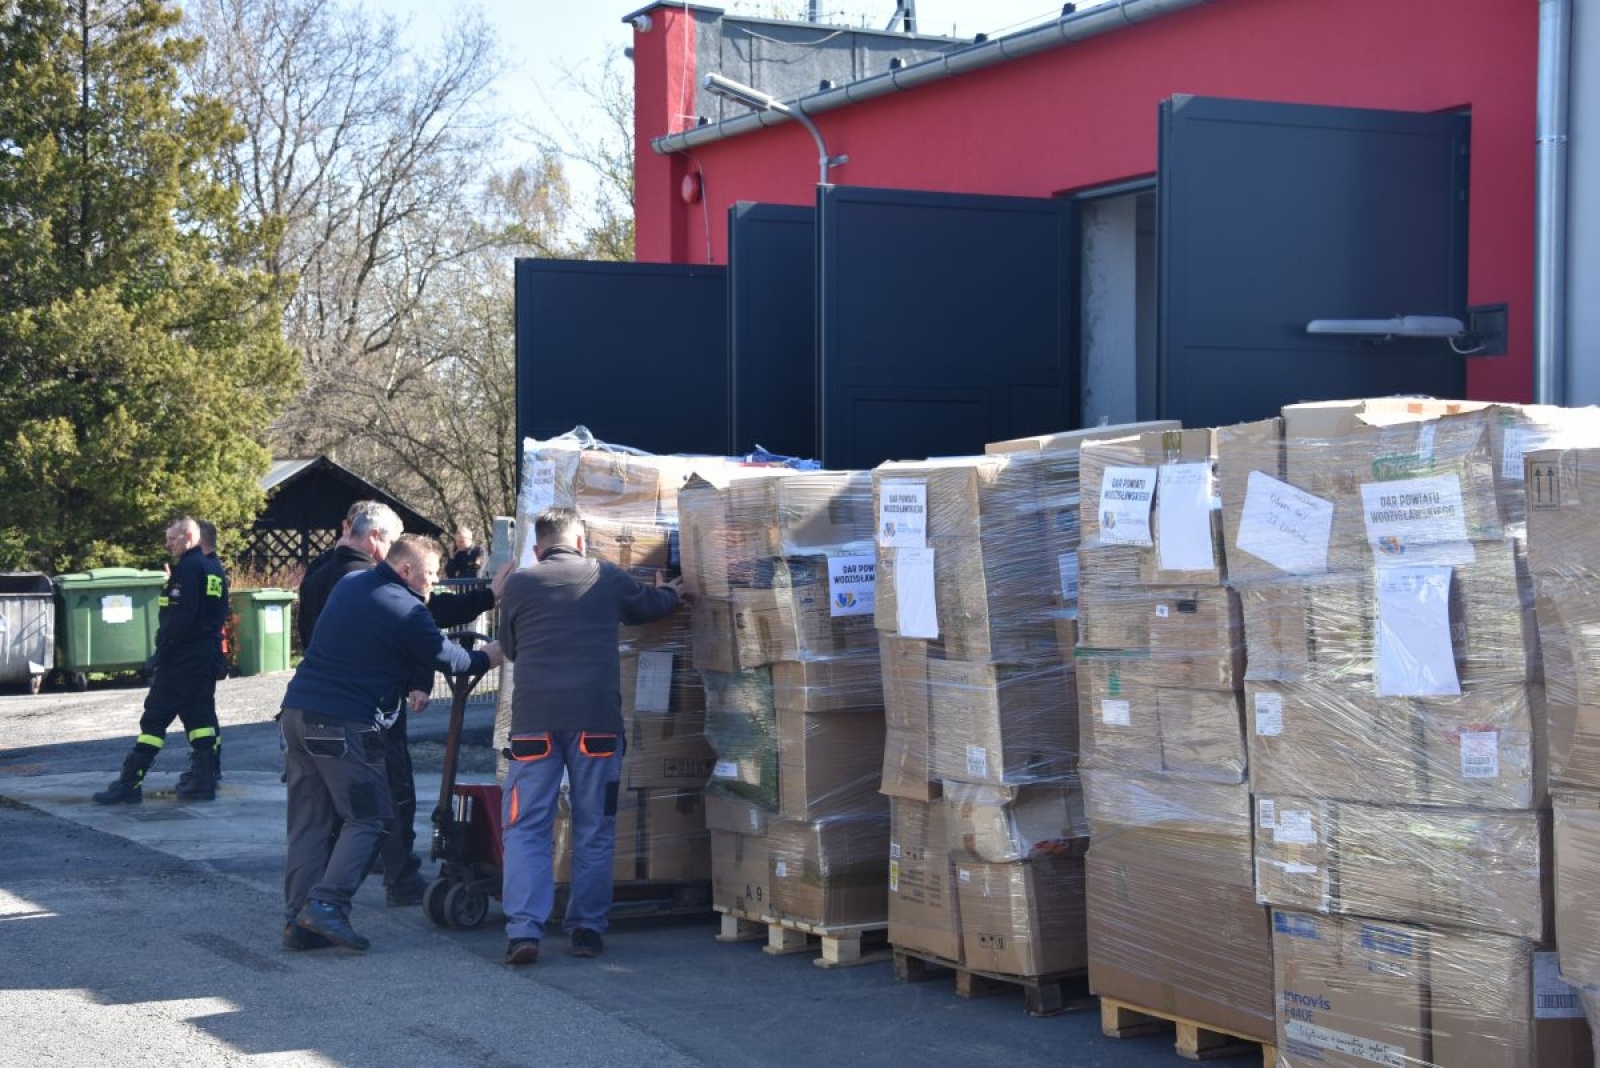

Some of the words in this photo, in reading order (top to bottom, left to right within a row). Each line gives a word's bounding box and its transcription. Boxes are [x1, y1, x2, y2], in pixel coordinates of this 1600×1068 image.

[1380, 495, 1397, 508] DAR
[1399, 492, 1440, 507] POWIATU
[843, 564, 857, 574] DAR
